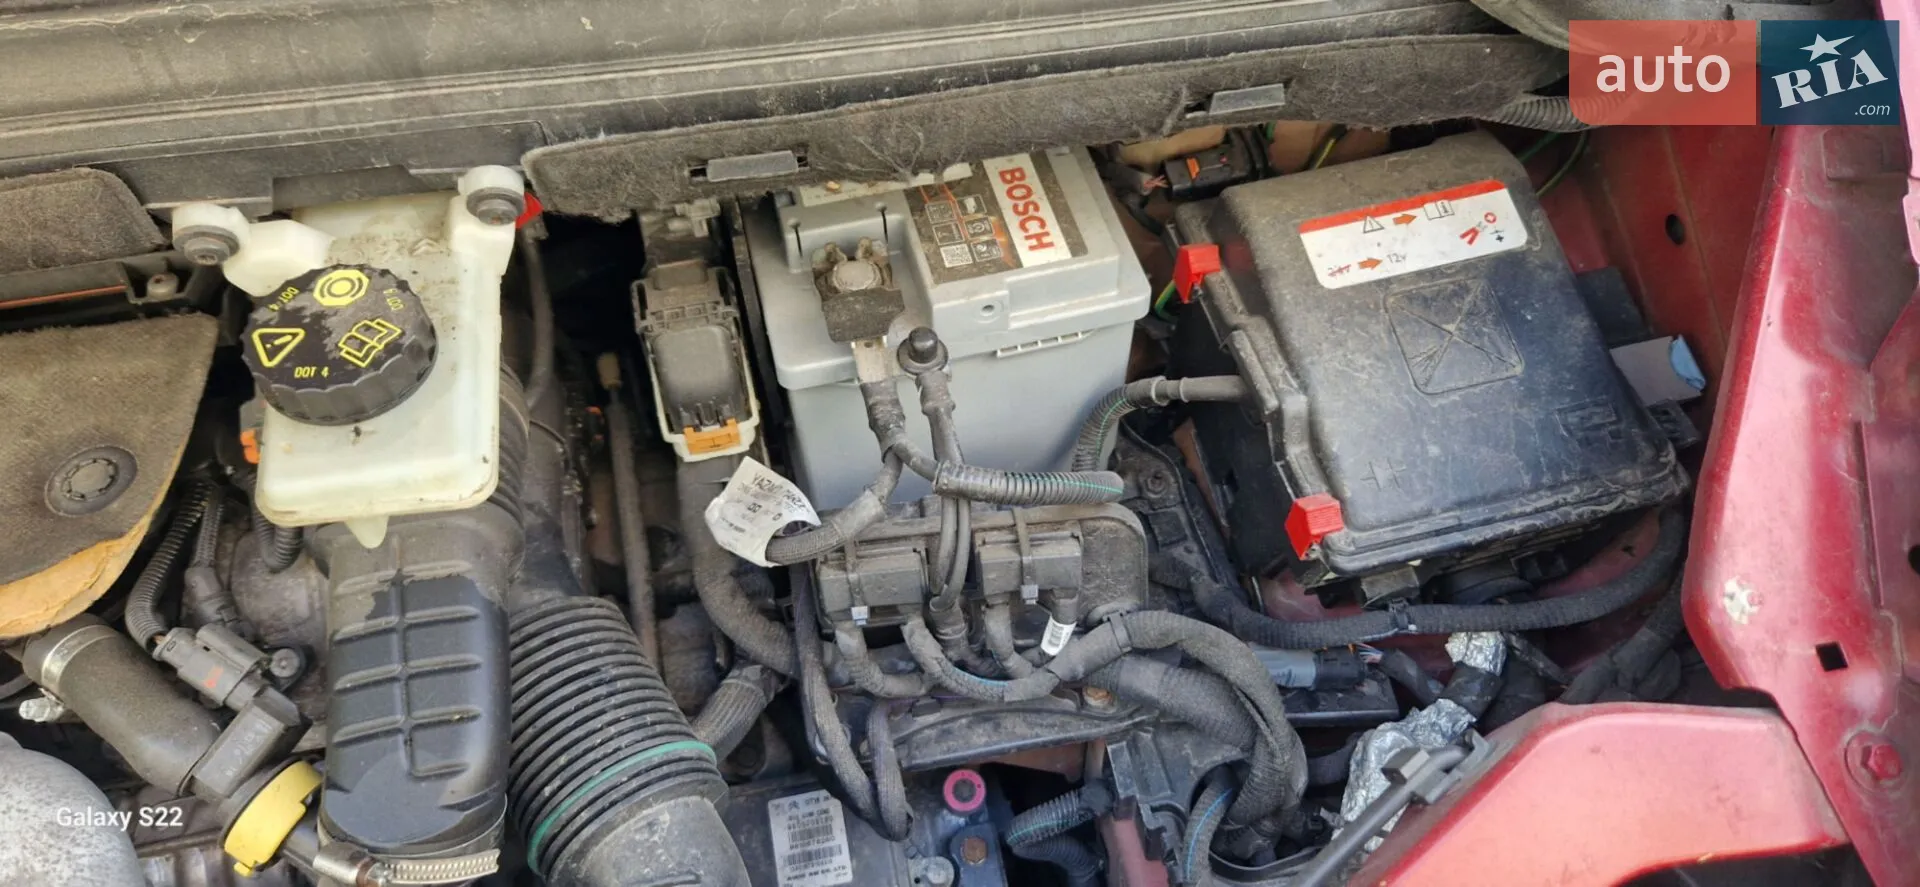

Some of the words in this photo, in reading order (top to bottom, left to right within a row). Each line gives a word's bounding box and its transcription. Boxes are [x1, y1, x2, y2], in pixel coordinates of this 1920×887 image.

[998, 167, 1055, 252] BOSCH
[294, 366, 315, 379] DOT
[321, 366, 330, 378] 4
